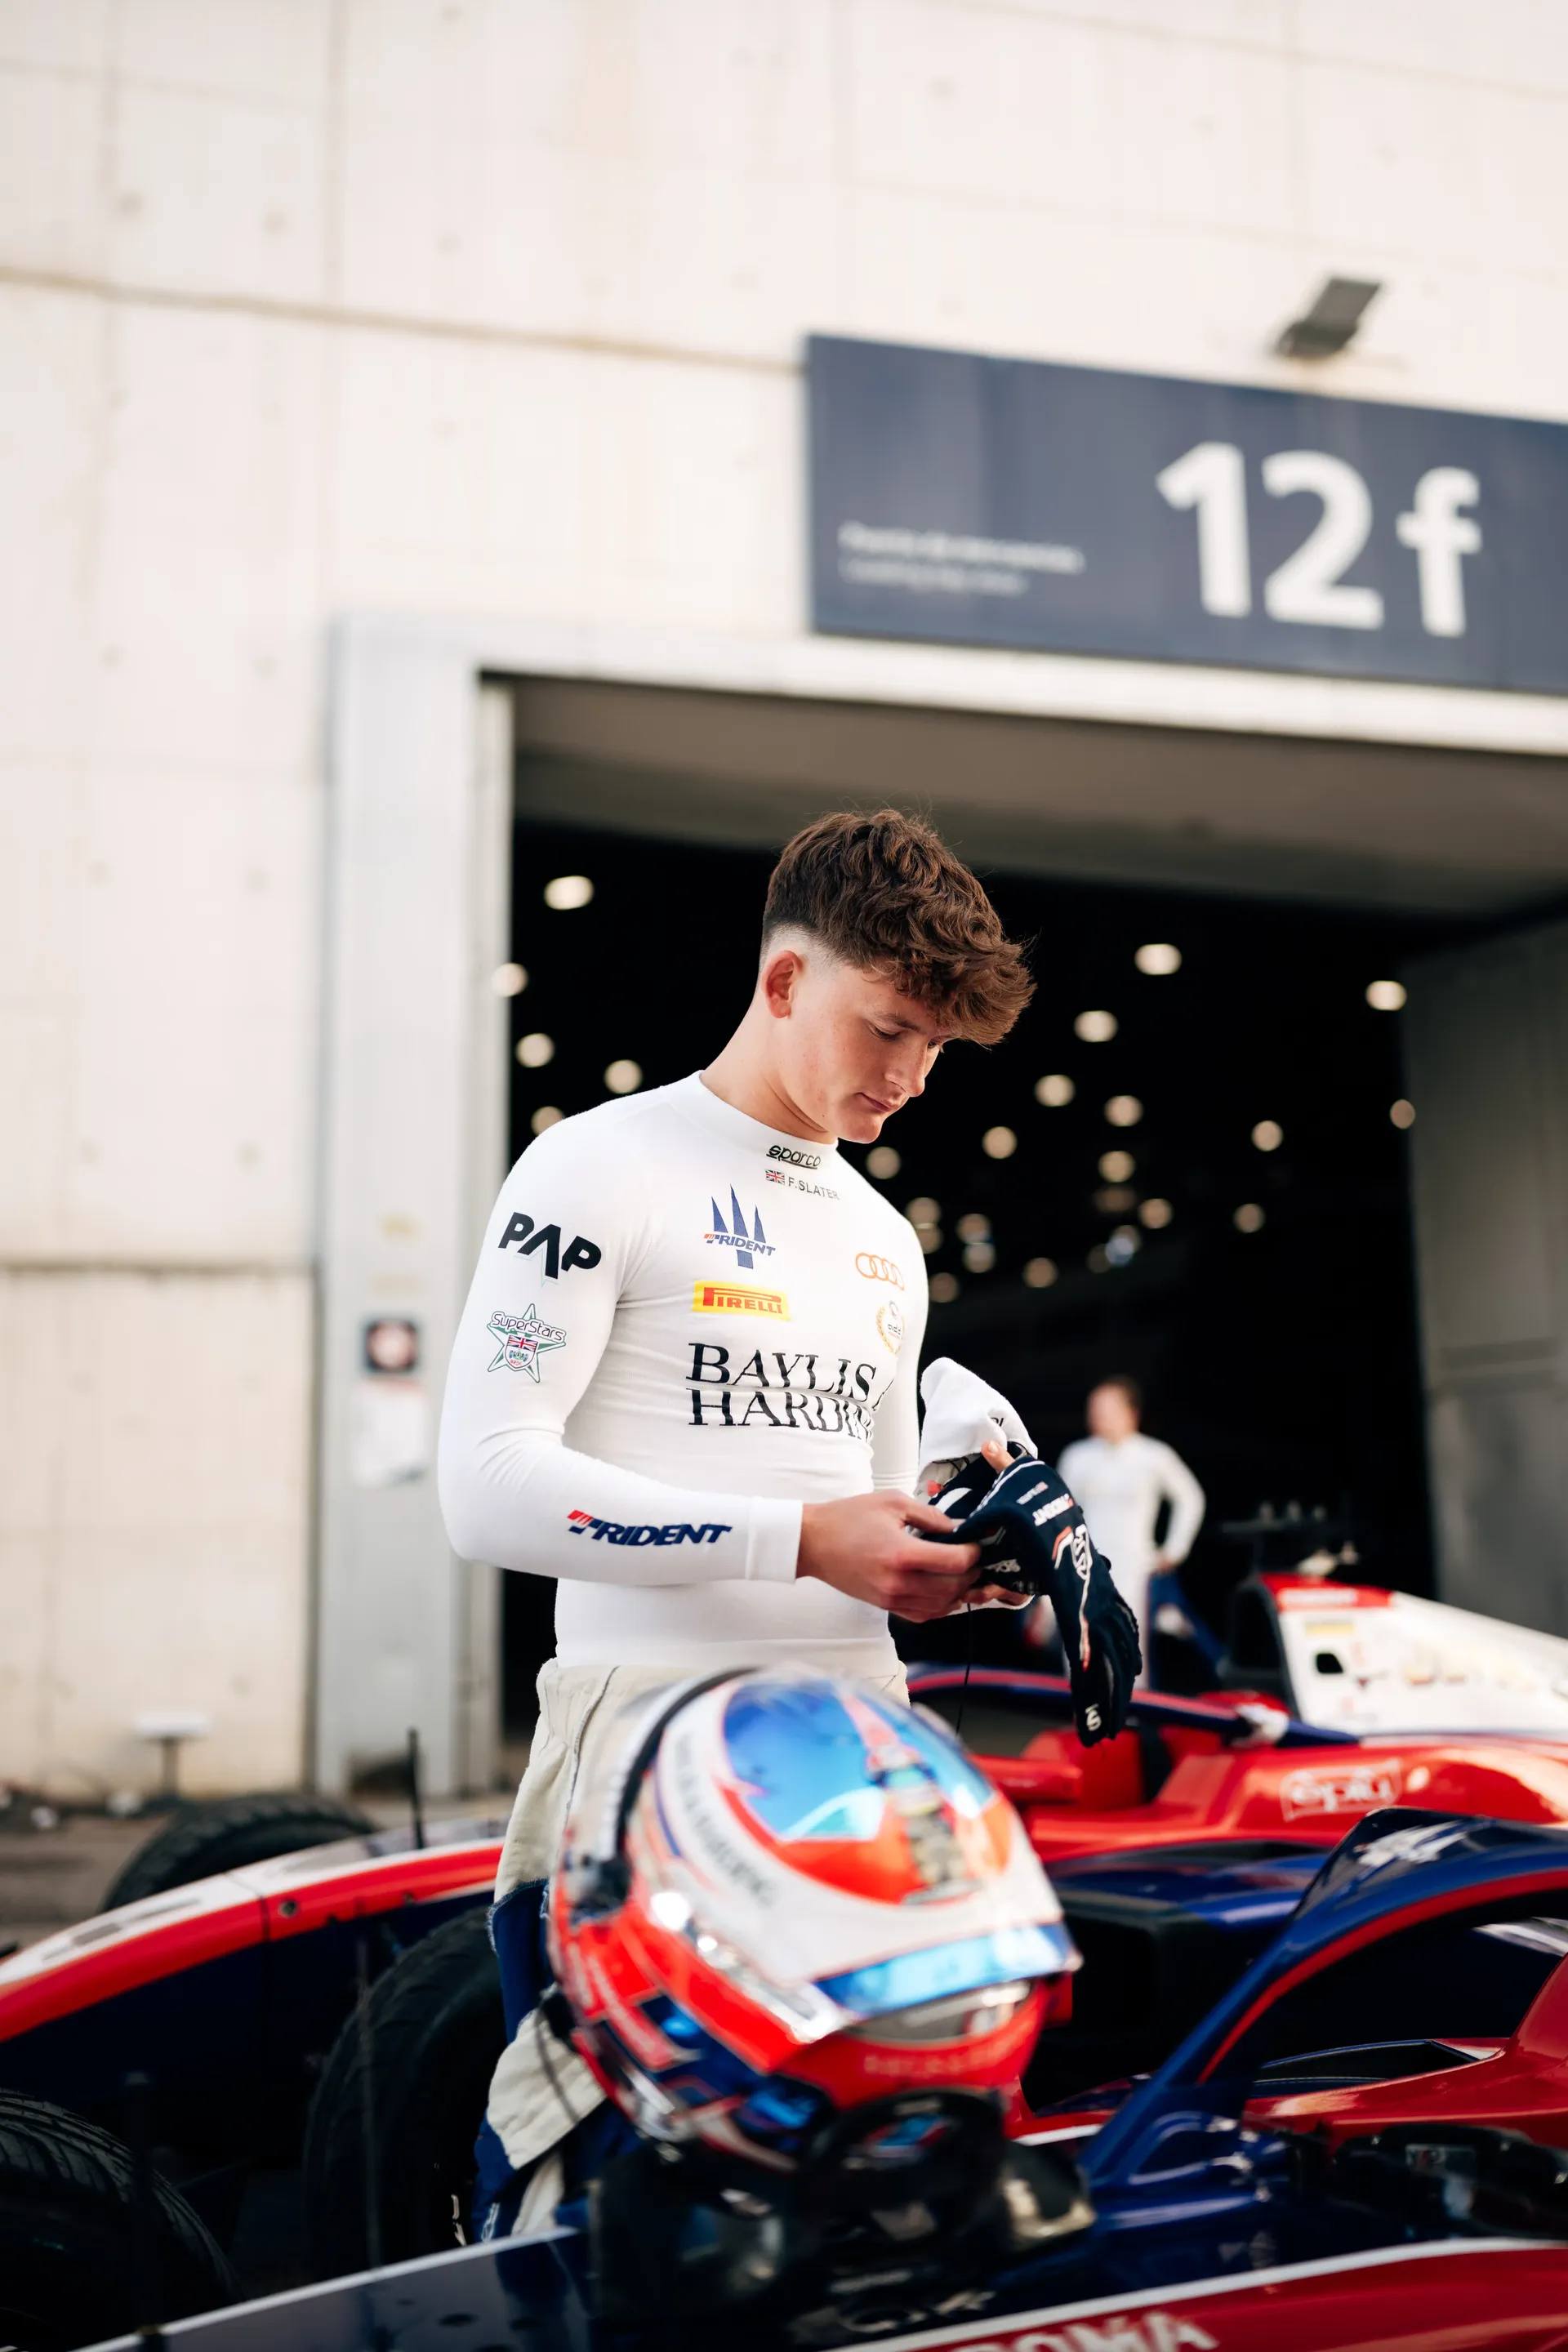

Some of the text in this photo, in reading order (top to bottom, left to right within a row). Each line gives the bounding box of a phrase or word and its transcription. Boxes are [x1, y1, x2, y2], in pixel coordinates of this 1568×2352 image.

[766, 1145, 822, 1169] sparco
[704, 1232, 776, 1257] TRIDENT
[703, 1287, 782, 1315] PIRELLI
[492, 1313, 564, 1342] SuperStars
[685, 1343, 877, 1403] BAYLIS
[567, 1509, 733, 1547] TRIDENT
